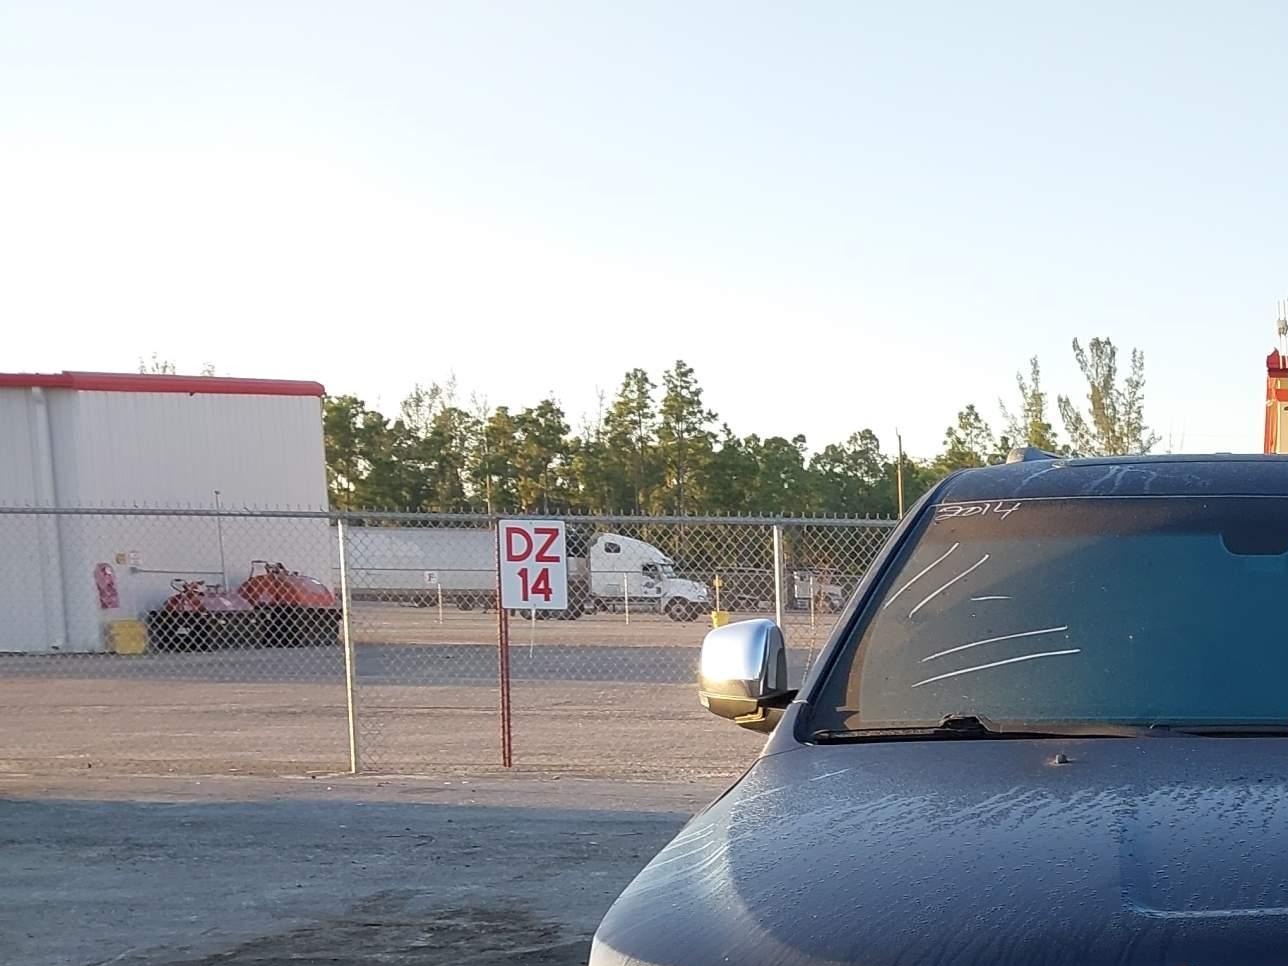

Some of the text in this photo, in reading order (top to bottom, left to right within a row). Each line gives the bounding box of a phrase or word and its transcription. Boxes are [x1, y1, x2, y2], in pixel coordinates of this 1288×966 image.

[934, 501, 1022, 521] 2014
[505, 526, 561, 563] DZ
[517, 567, 553, 602] 14
